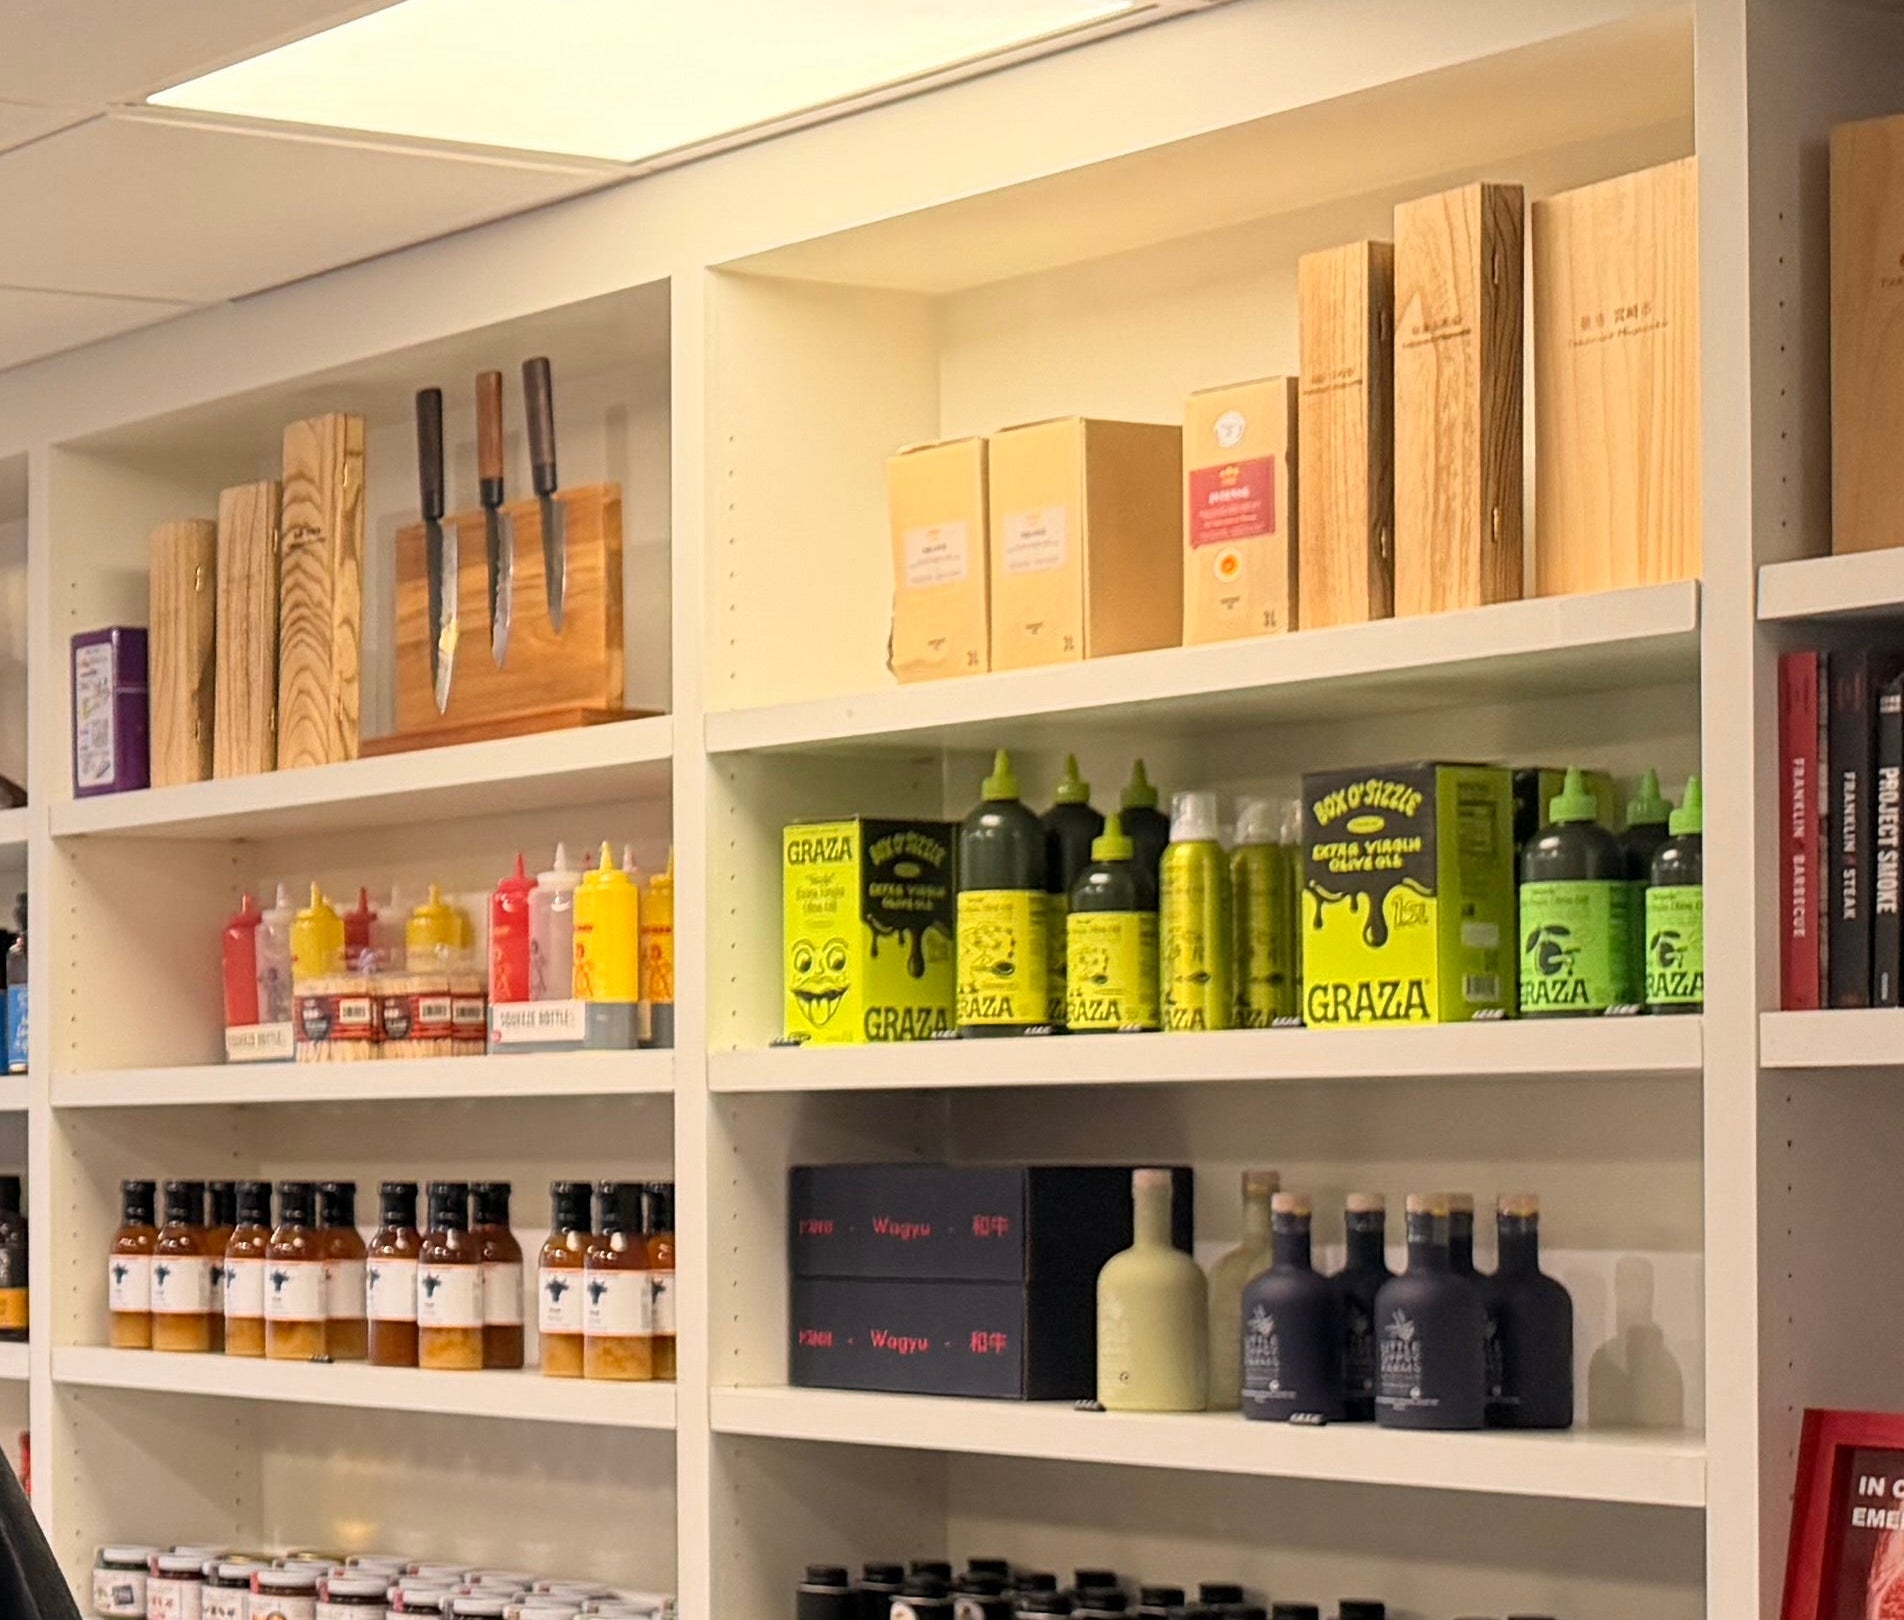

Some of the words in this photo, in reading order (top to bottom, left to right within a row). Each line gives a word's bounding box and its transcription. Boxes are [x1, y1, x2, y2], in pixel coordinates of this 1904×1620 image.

[1313, 789, 1348, 826] BOX
[1792, 757, 1805, 839] FRANKLIN
[1843, 771, 1856, 853] FRANKLIN
[1877, 766, 1900, 848] PROJECT
[787, 836, 853, 866] GRAZA
[1312, 841, 1359, 861] EXTRA
[1364, 836, 1422, 854] VIRGIN
[1329, 855, 1373, 873] OLIVE
[1375, 853, 1403, 870] OIL
[1792, 854, 1805, 938] BARBECUE
[1843, 868, 1856, 920] STEAK
[1876, 849, 1898, 915] SMOKE
[1308, 979, 1427, 1025] GRAZA
[864, 1005, 948, 1042] GRAZA
[872, 1216, 932, 1241] Wagyu
[870, 1329, 929, 1355] Wagyu
[1858, 1475, 1886, 1497] IN
[1852, 1506, 1904, 1530] EME
